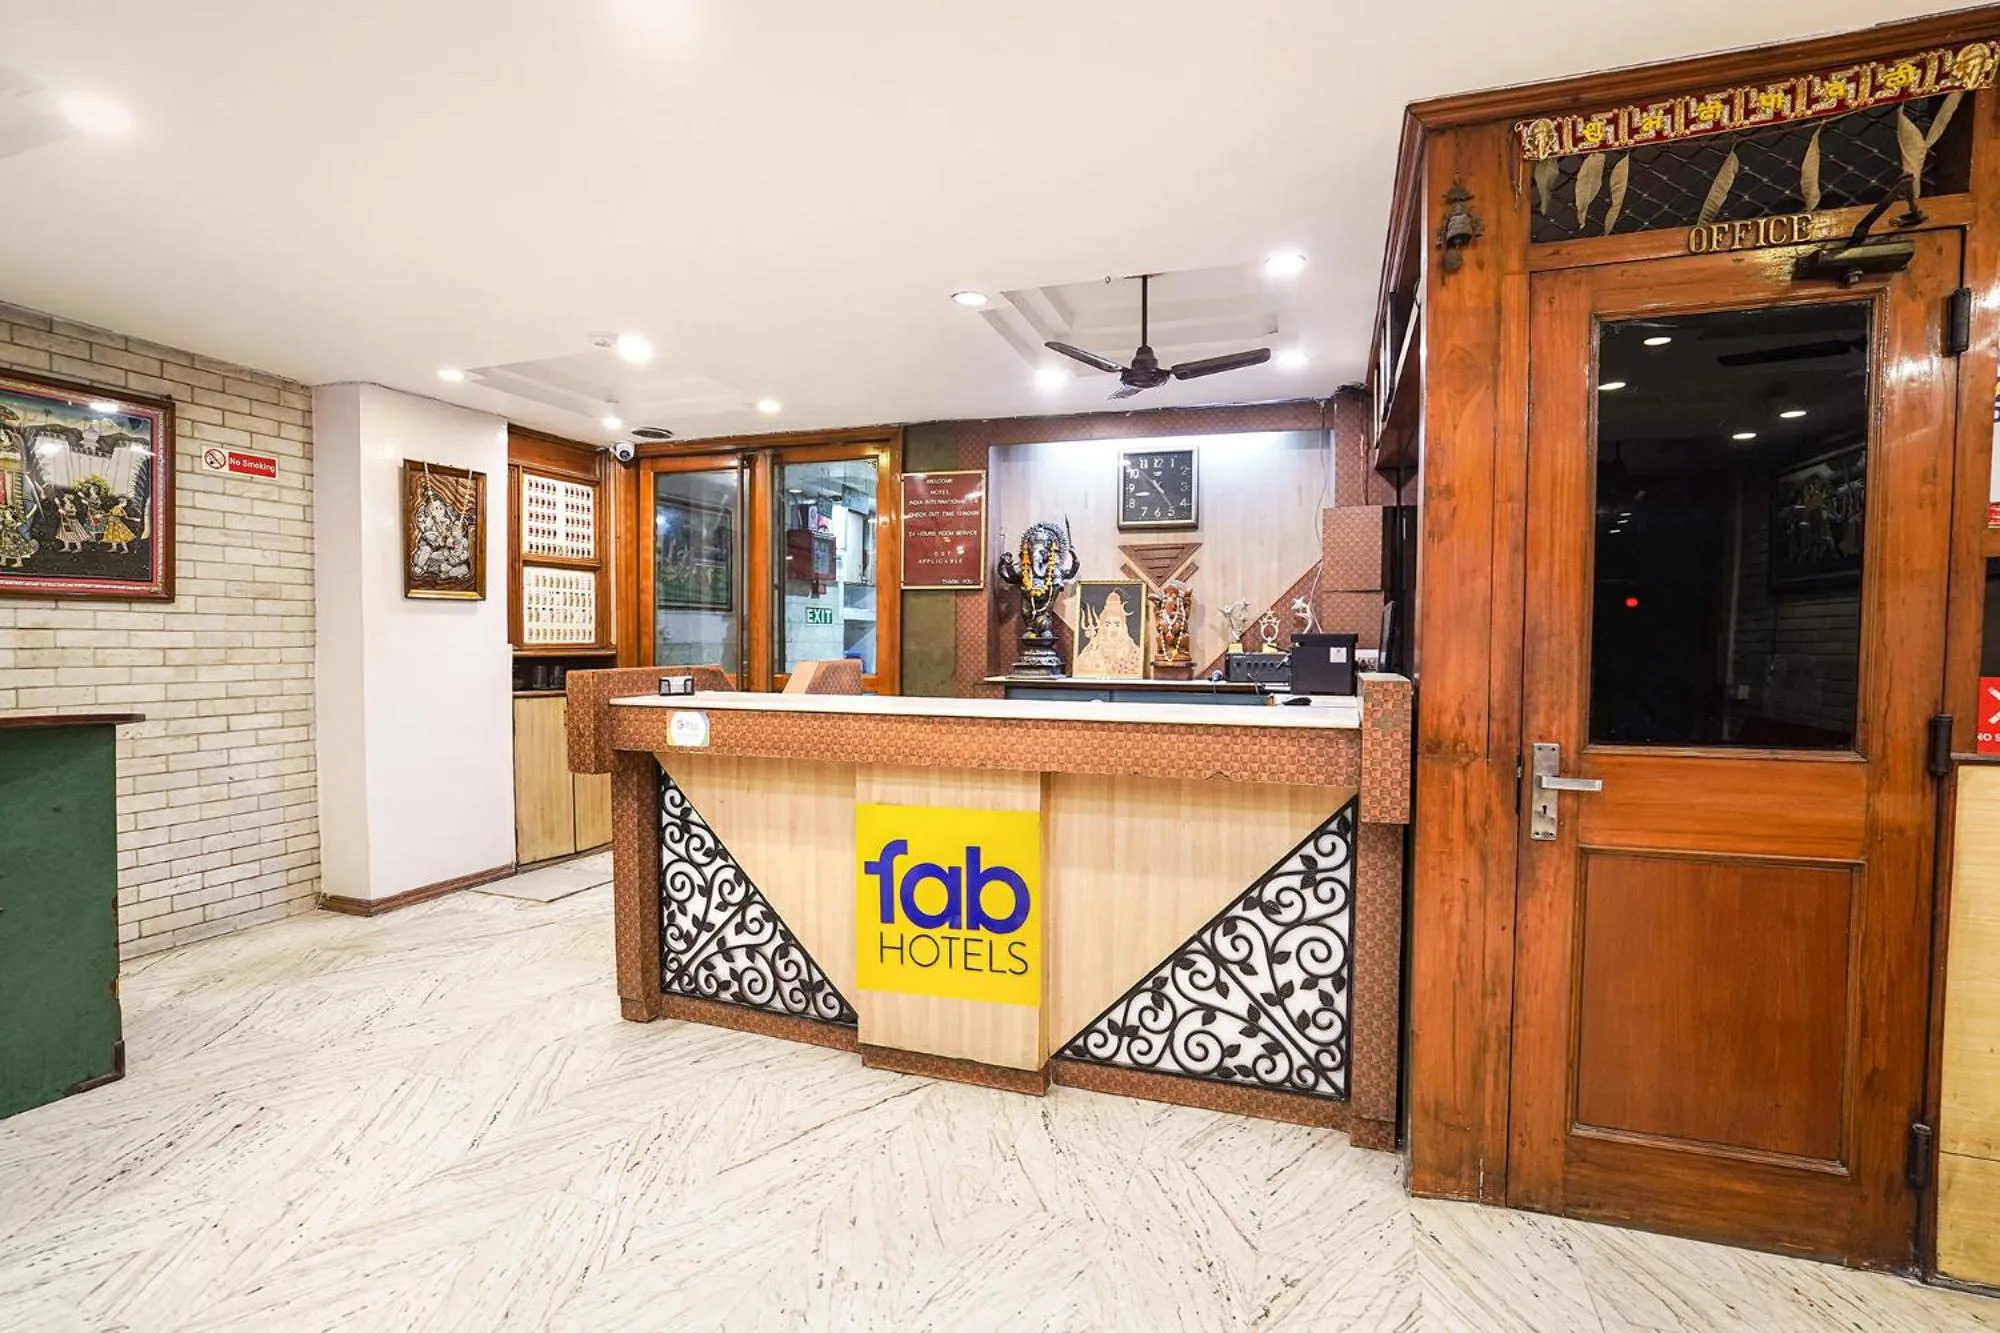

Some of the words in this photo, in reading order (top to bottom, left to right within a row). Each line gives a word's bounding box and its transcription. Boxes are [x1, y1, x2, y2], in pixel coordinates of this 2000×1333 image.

[1688, 214, 1812, 253] OFFICE
[229, 457, 241, 466] No
[242, 459, 276, 474] Smoking
[1153, 458, 1164, 468] 12
[1171, 458, 1176, 468] 1
[1127, 468, 1140, 479] 10
[1129, 483, 1136, 493] 9
[1128, 498, 1136, 509] 8
[1179, 497, 1188, 508] 4
[1141, 506, 1148, 516] 7
[1154, 506, 1161, 517] 6
[1167, 506, 1176, 517] 5
[807, 608, 832, 623] EXIT
[864, 839, 1031, 934] fab
[880, 931, 1029, 976] HOTELS
